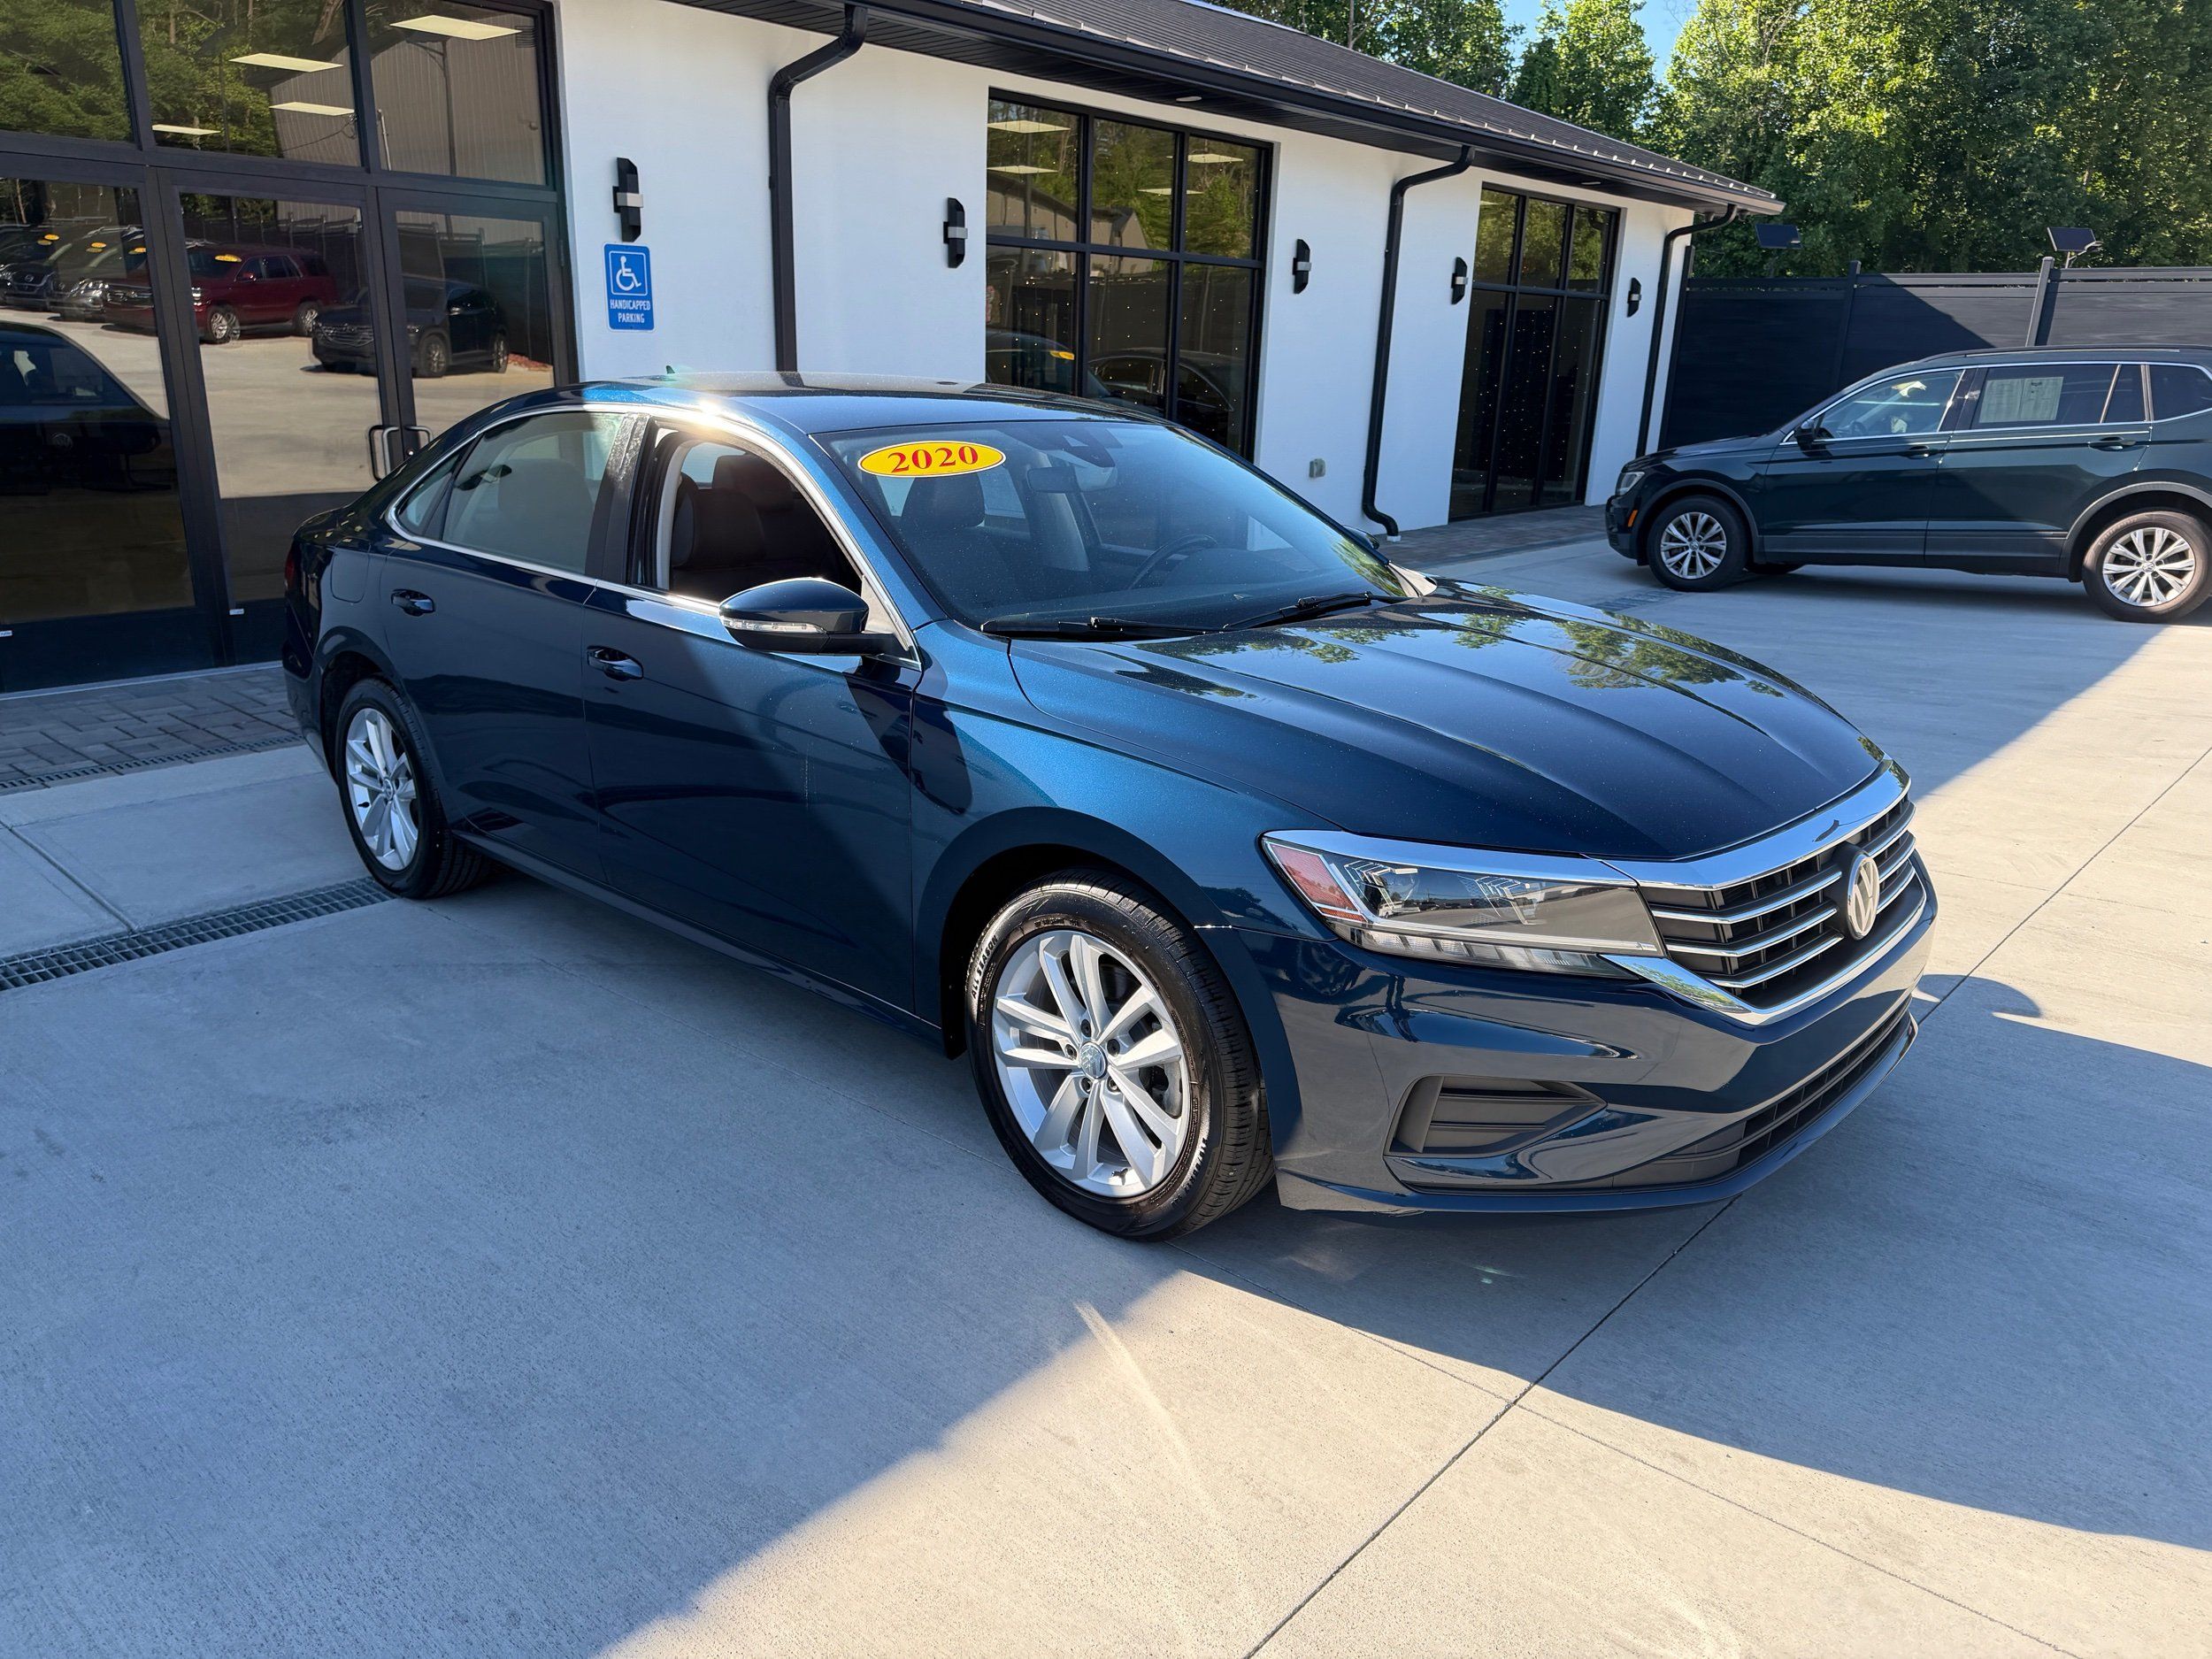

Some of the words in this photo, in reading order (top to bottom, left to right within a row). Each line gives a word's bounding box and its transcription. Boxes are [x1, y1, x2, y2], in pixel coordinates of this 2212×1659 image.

[610, 299, 651, 310] HANDICAPPED
[618, 312, 645, 323] PARKING
[887, 446, 979, 473] 2020
[976, 934, 999, 977] SEASON
